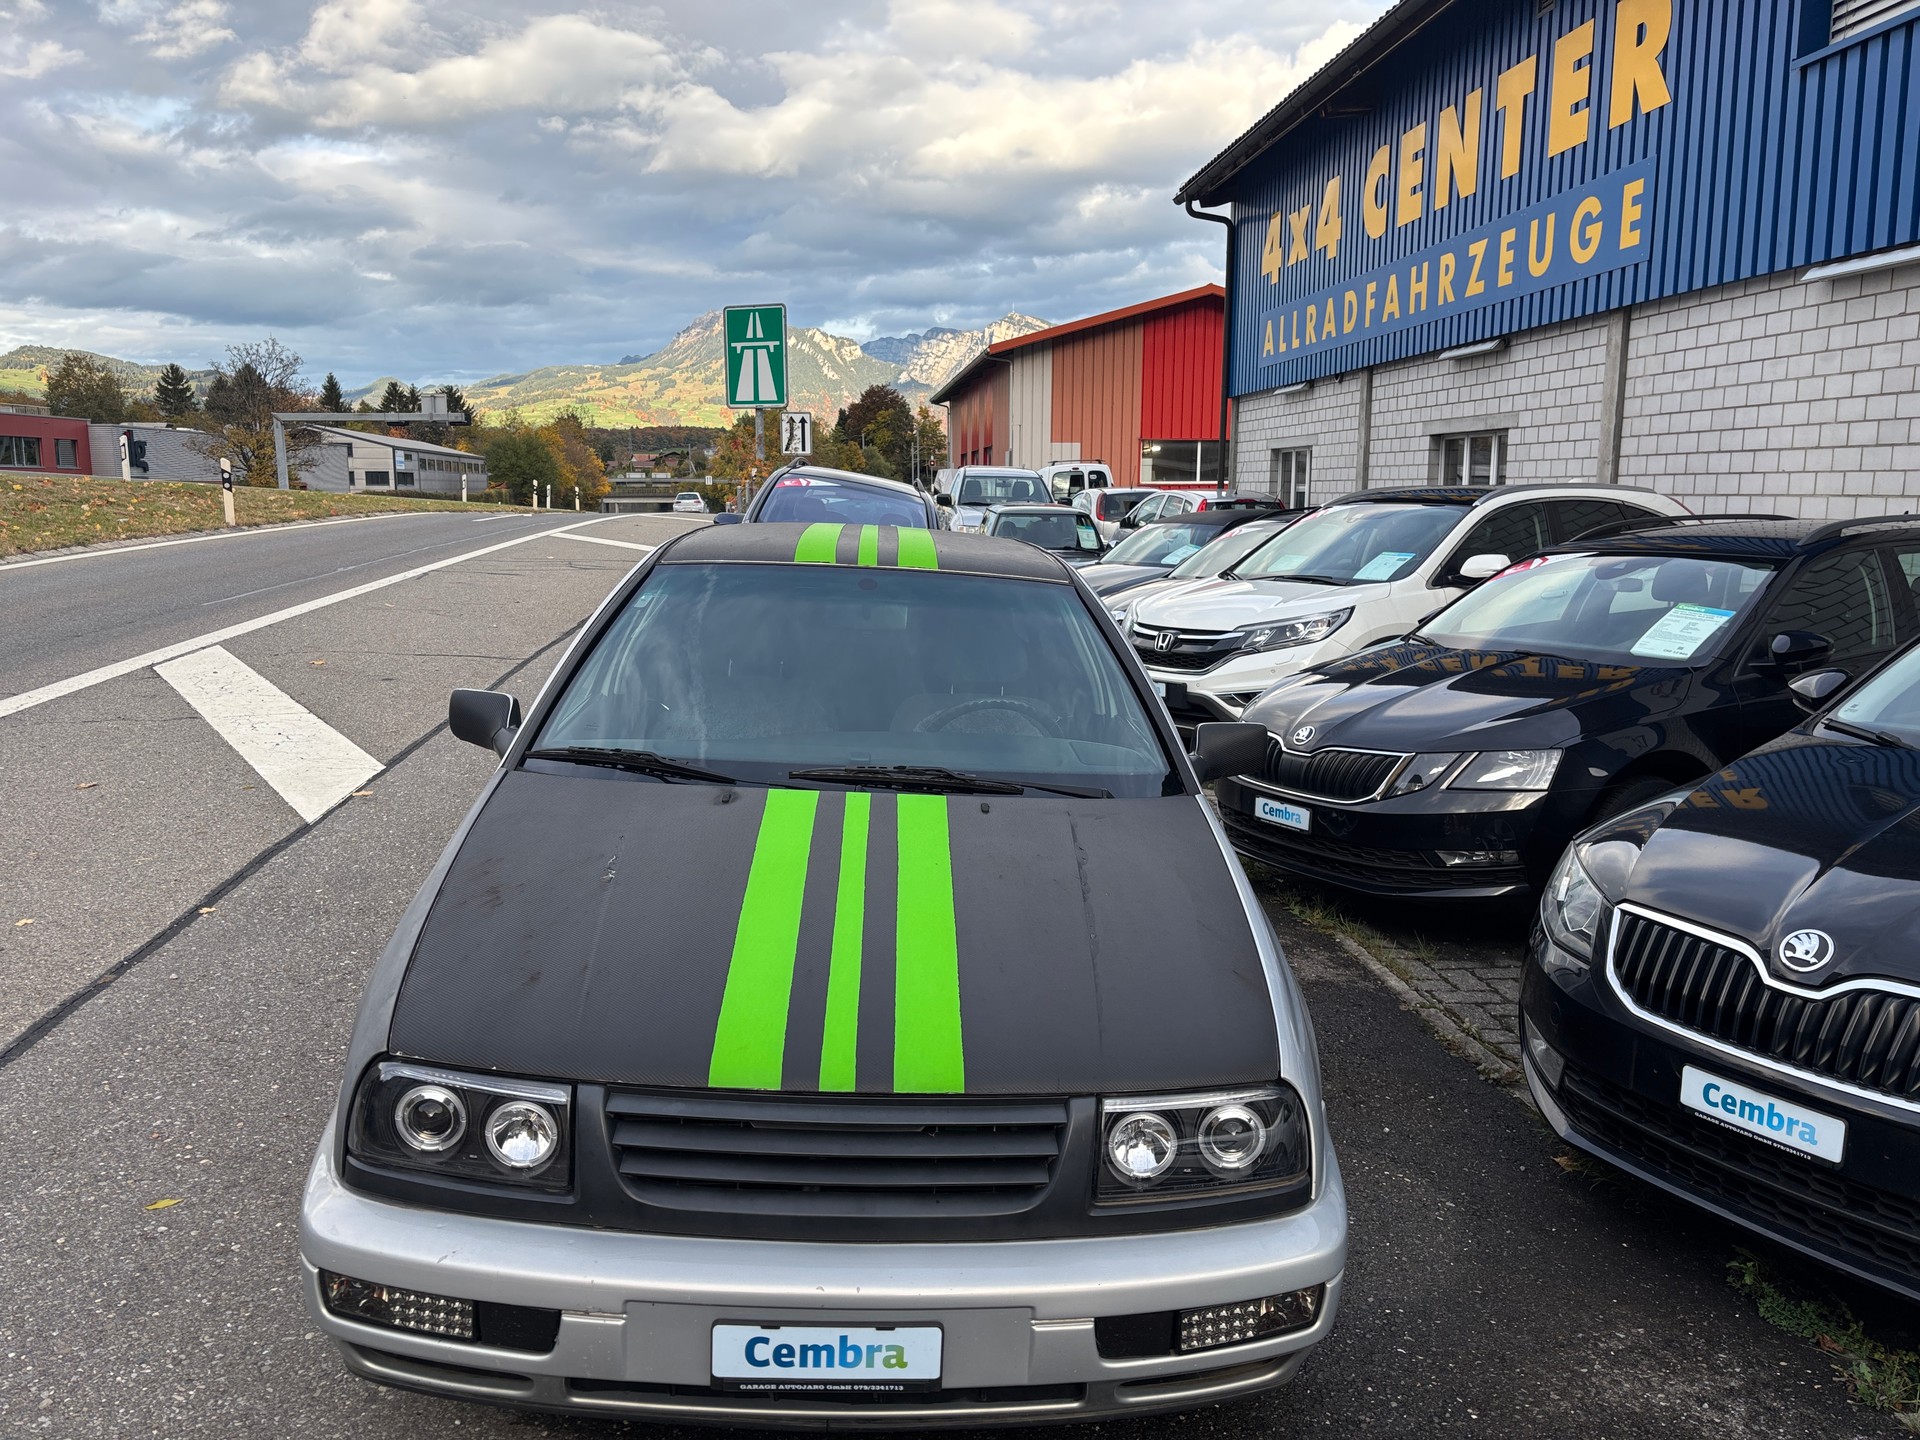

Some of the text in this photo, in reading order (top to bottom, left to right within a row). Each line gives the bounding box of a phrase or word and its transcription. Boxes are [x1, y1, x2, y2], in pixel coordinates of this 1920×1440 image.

[1261, 0, 1672, 285] 4x4 CENTER
[1262, 178, 1645, 358] ALLRADFAHRZEUGE
[1262, 802, 1302, 824] Cembra
[1702, 1082, 1818, 1146] Cembra
[743, 1335, 909, 1369] Cembra
[739, 1383, 777, 1391] GARAGE
[778, 1383, 825, 1391] AUTOJARO
